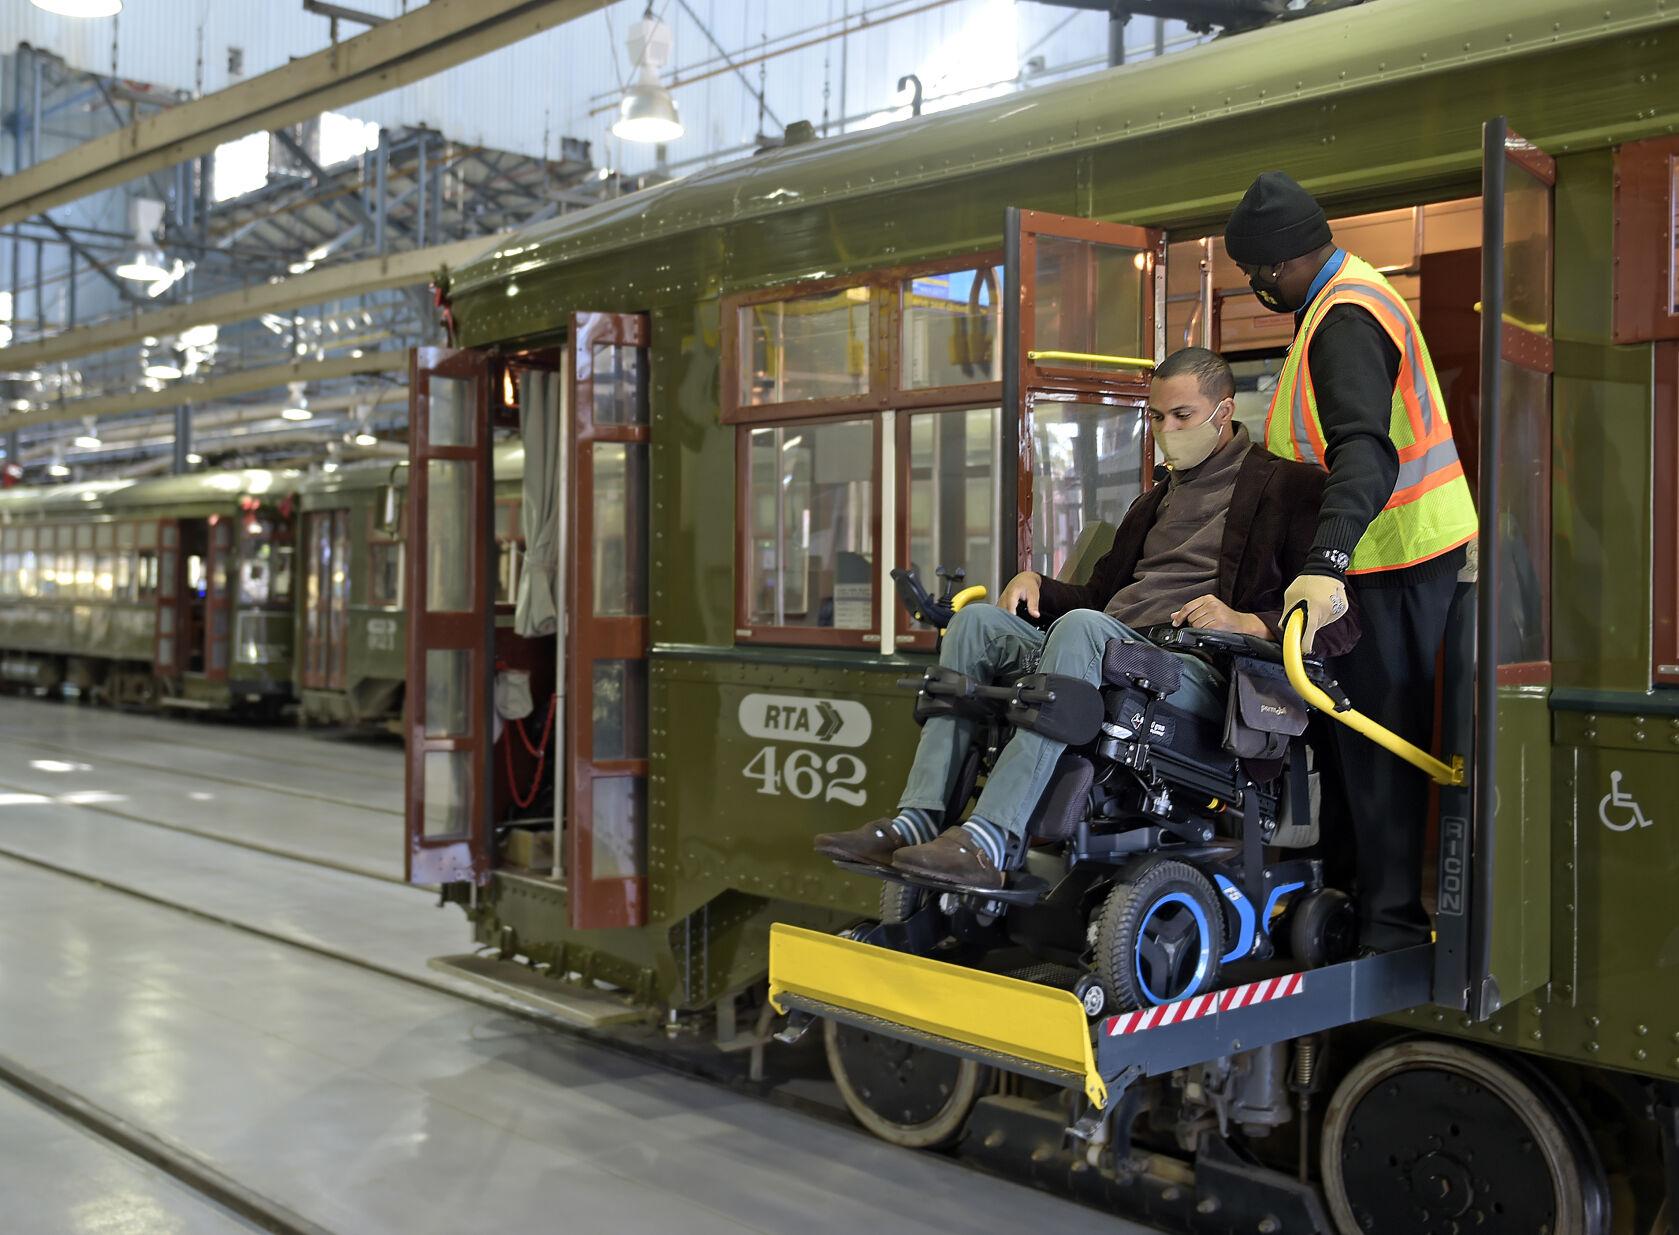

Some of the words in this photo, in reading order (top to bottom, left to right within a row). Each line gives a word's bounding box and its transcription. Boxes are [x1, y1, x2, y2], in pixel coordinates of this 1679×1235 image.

[764, 705, 809, 732] RTA
[742, 746, 867, 807] 462
[1442, 822, 1462, 910] RICON
